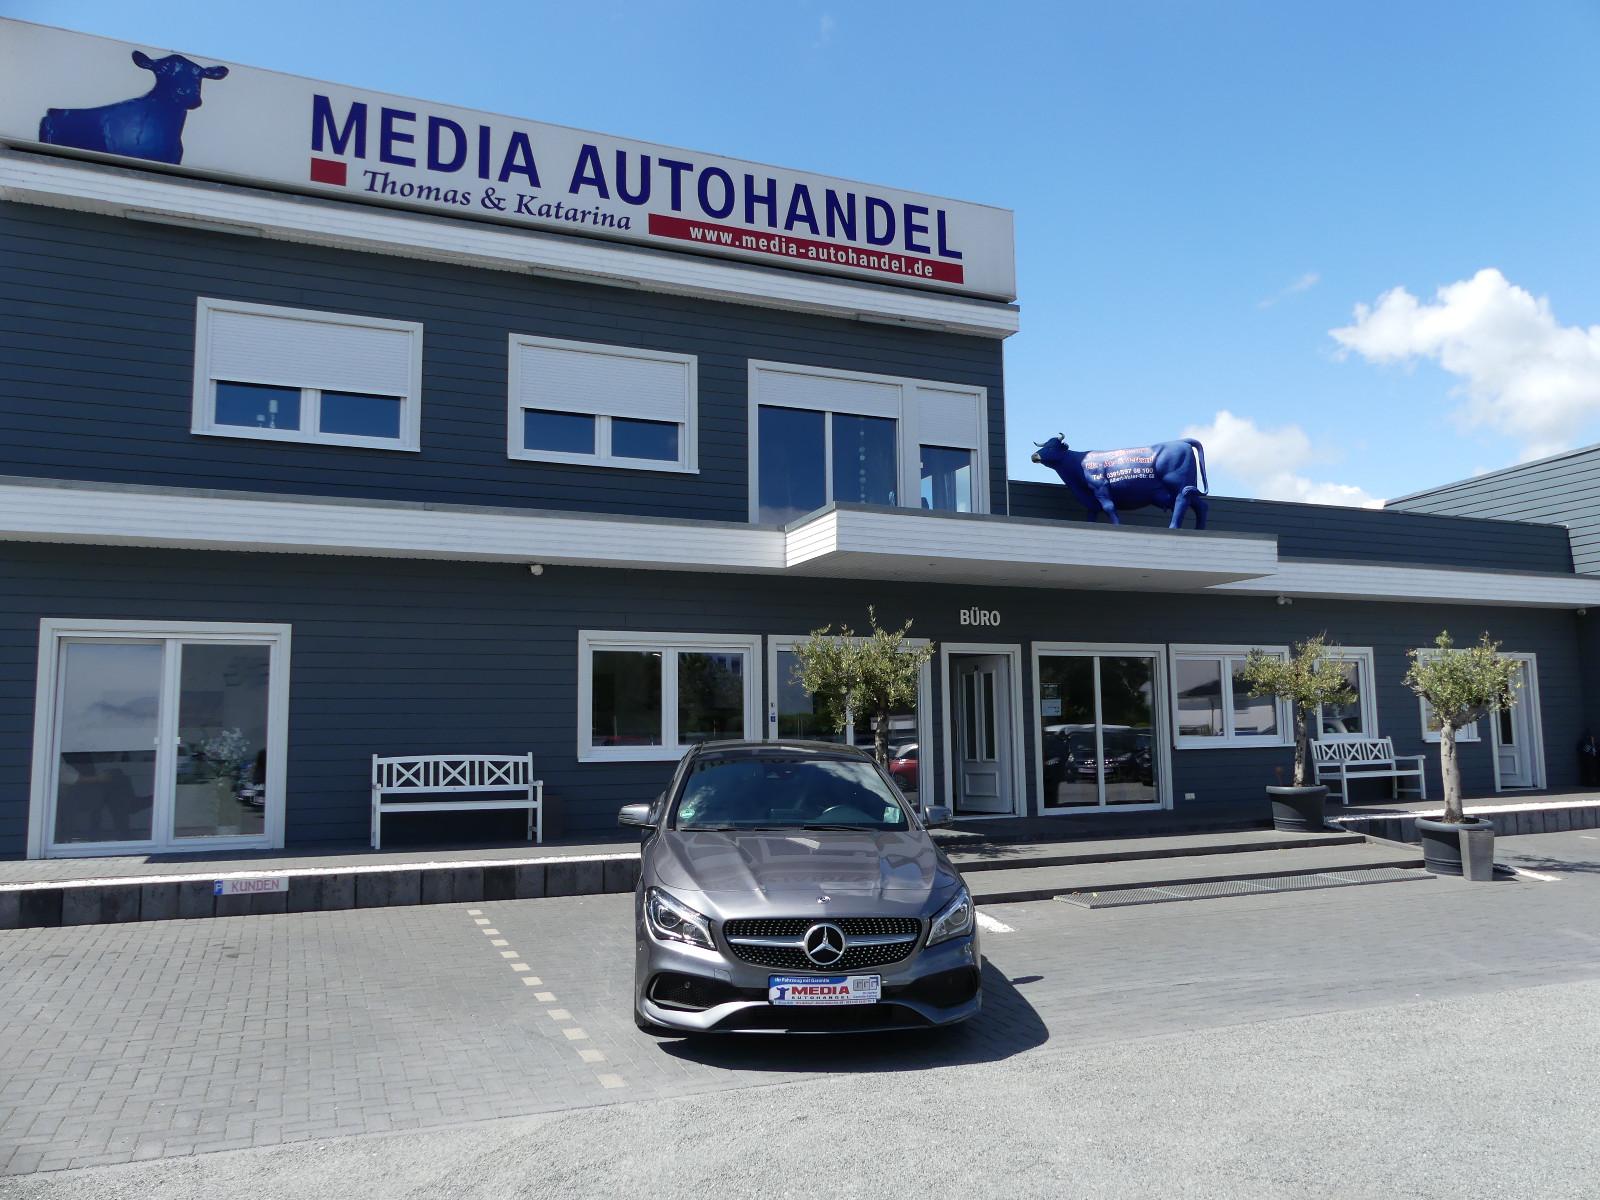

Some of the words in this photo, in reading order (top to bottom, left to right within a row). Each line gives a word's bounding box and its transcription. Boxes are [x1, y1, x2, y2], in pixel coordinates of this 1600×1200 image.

[311, 94, 541, 188] MEDIA
[568, 144, 963, 260] AUTOHANDEL
[363, 169, 471, 206] Thomas
[480, 187, 506, 211] &
[513, 193, 632, 230] Katarina
[689, 224, 933, 278] www.media-autohandel.de
[960, 606, 1000, 626] BÜRO
[231, 880, 280, 893] KUNDEN
[791, 985, 850, 995] MEDIA
